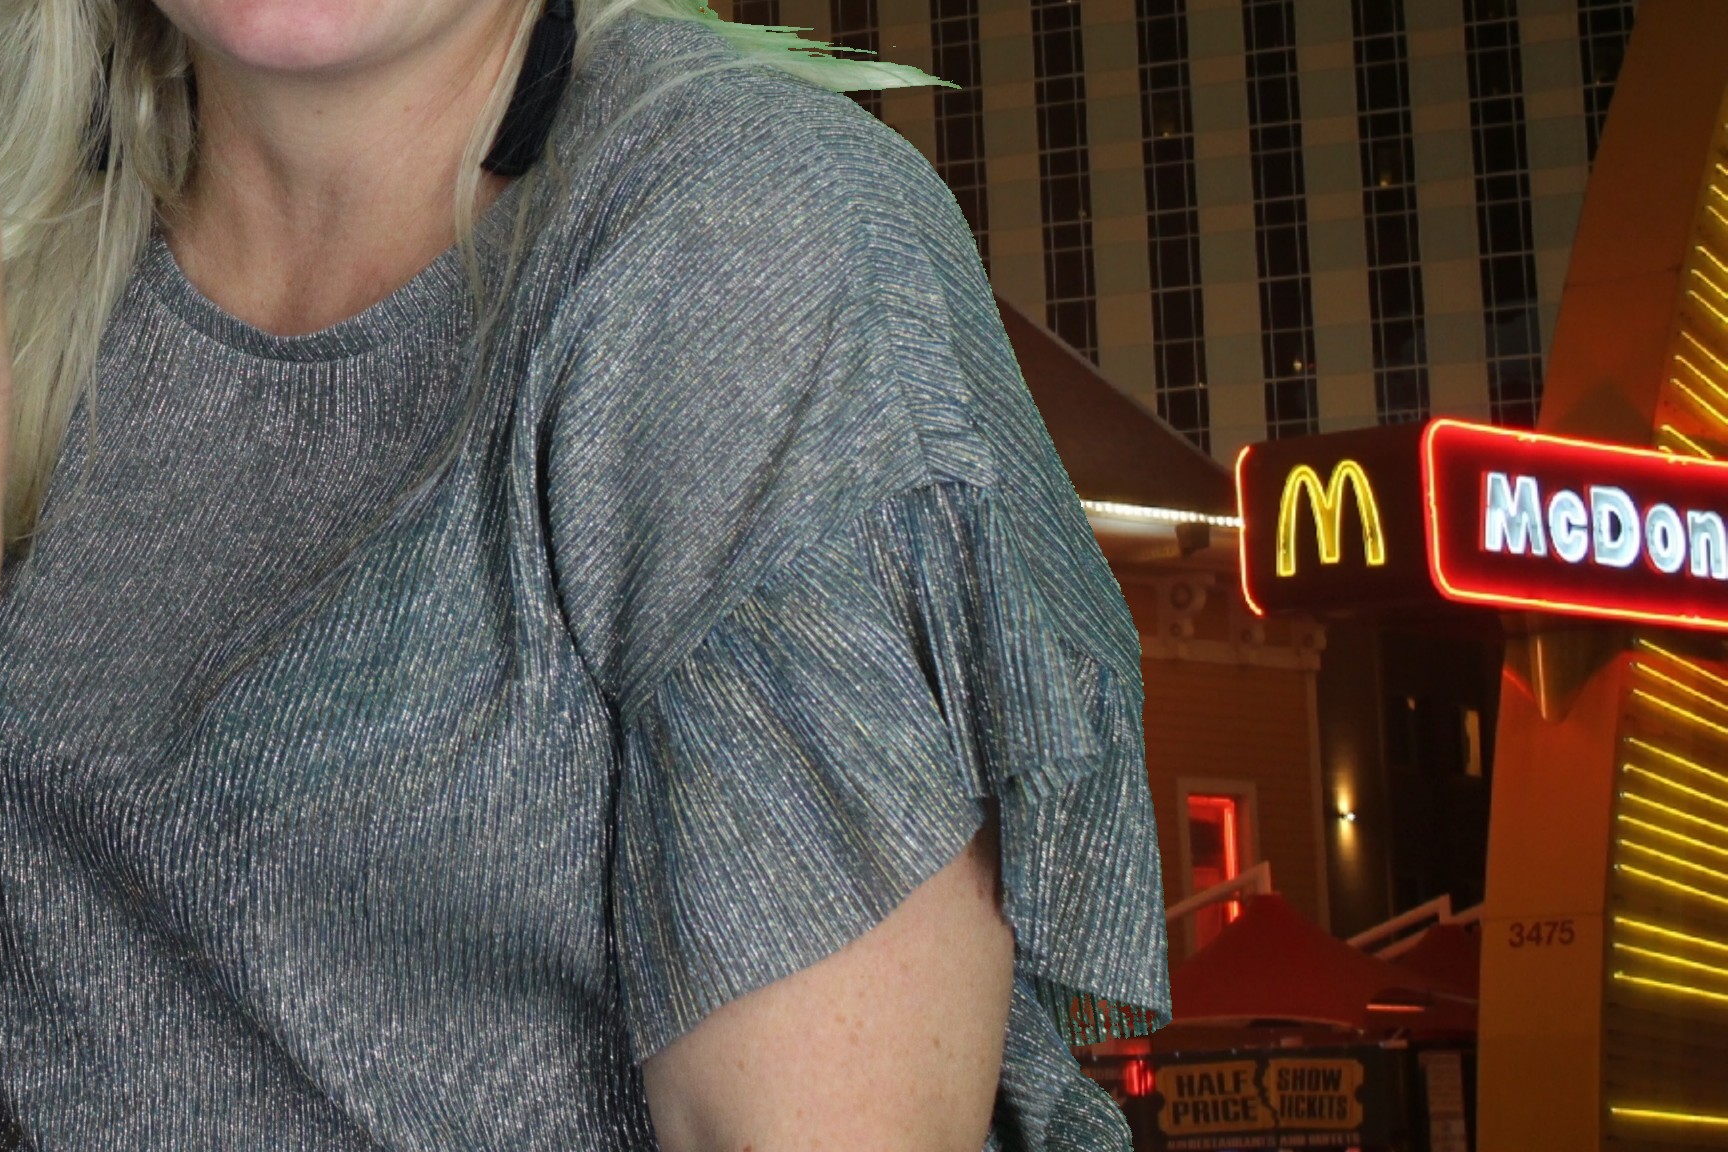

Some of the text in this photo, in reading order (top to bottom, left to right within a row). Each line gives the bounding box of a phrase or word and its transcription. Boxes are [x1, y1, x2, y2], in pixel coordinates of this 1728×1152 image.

[1484, 471, 1728, 580] McDon
[1508, 920, 1575, 948] 3475
[1176, 1069, 1248, 1098] HALF
[1278, 1068, 1342, 1091] SHOW
[1172, 1097, 1257, 1125] PRICE
[1279, 1094, 1347, 1120] TICKETS
